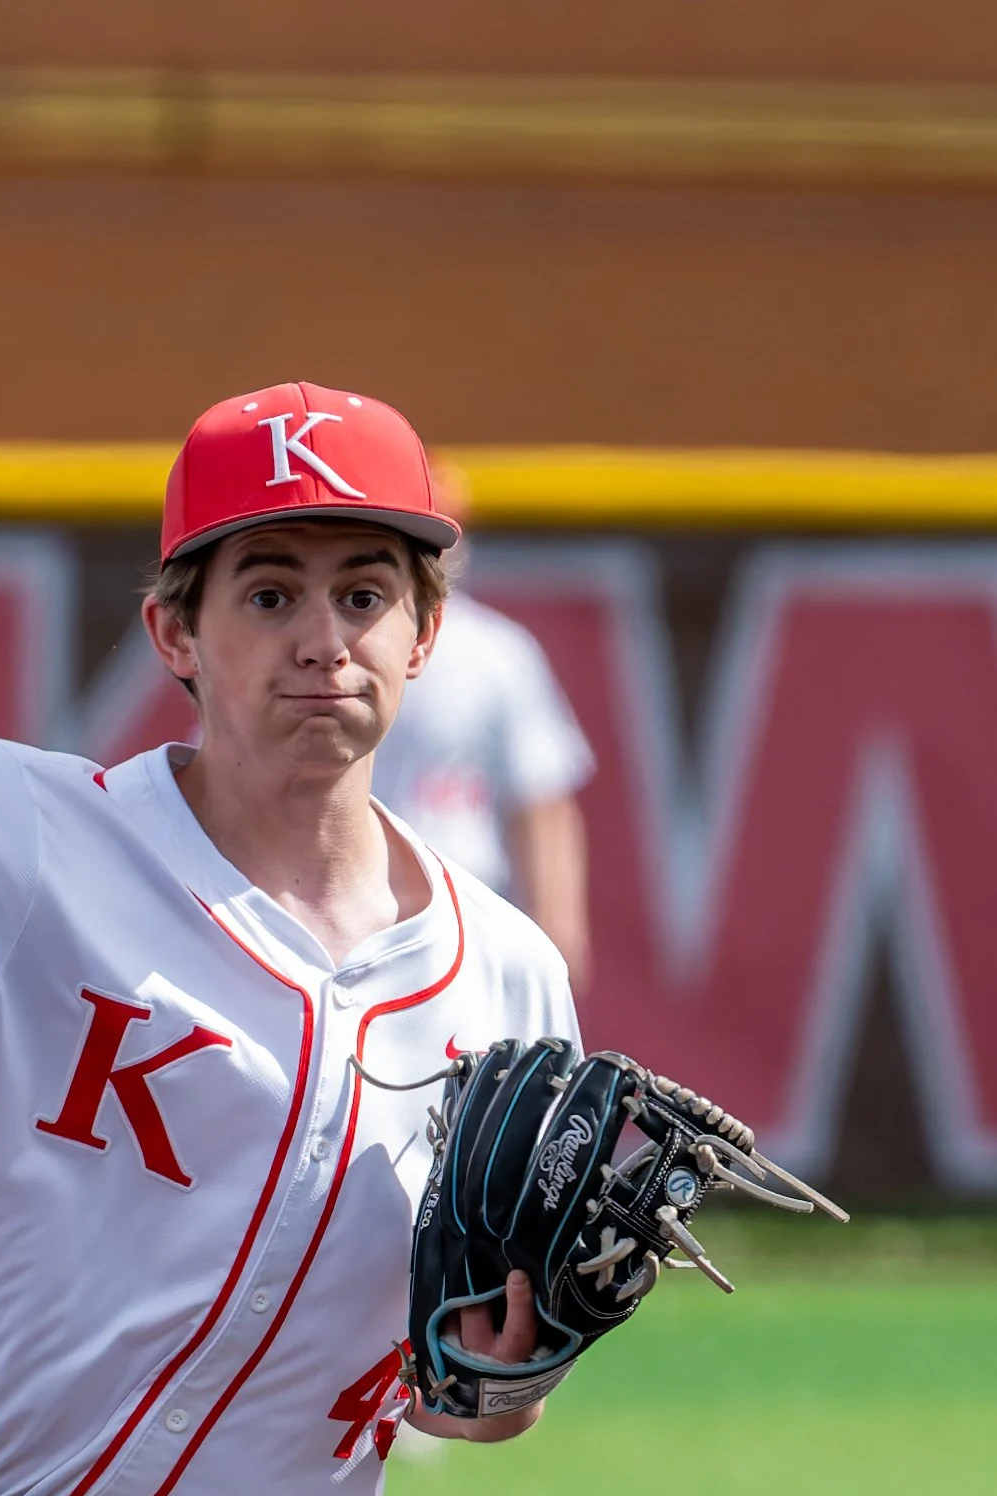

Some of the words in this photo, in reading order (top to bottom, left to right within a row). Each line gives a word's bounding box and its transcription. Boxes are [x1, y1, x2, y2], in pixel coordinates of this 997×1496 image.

[258, 412, 368, 500] K
[34, 986, 234, 1190] K
[538, 1114, 593, 1211] Rawlings
